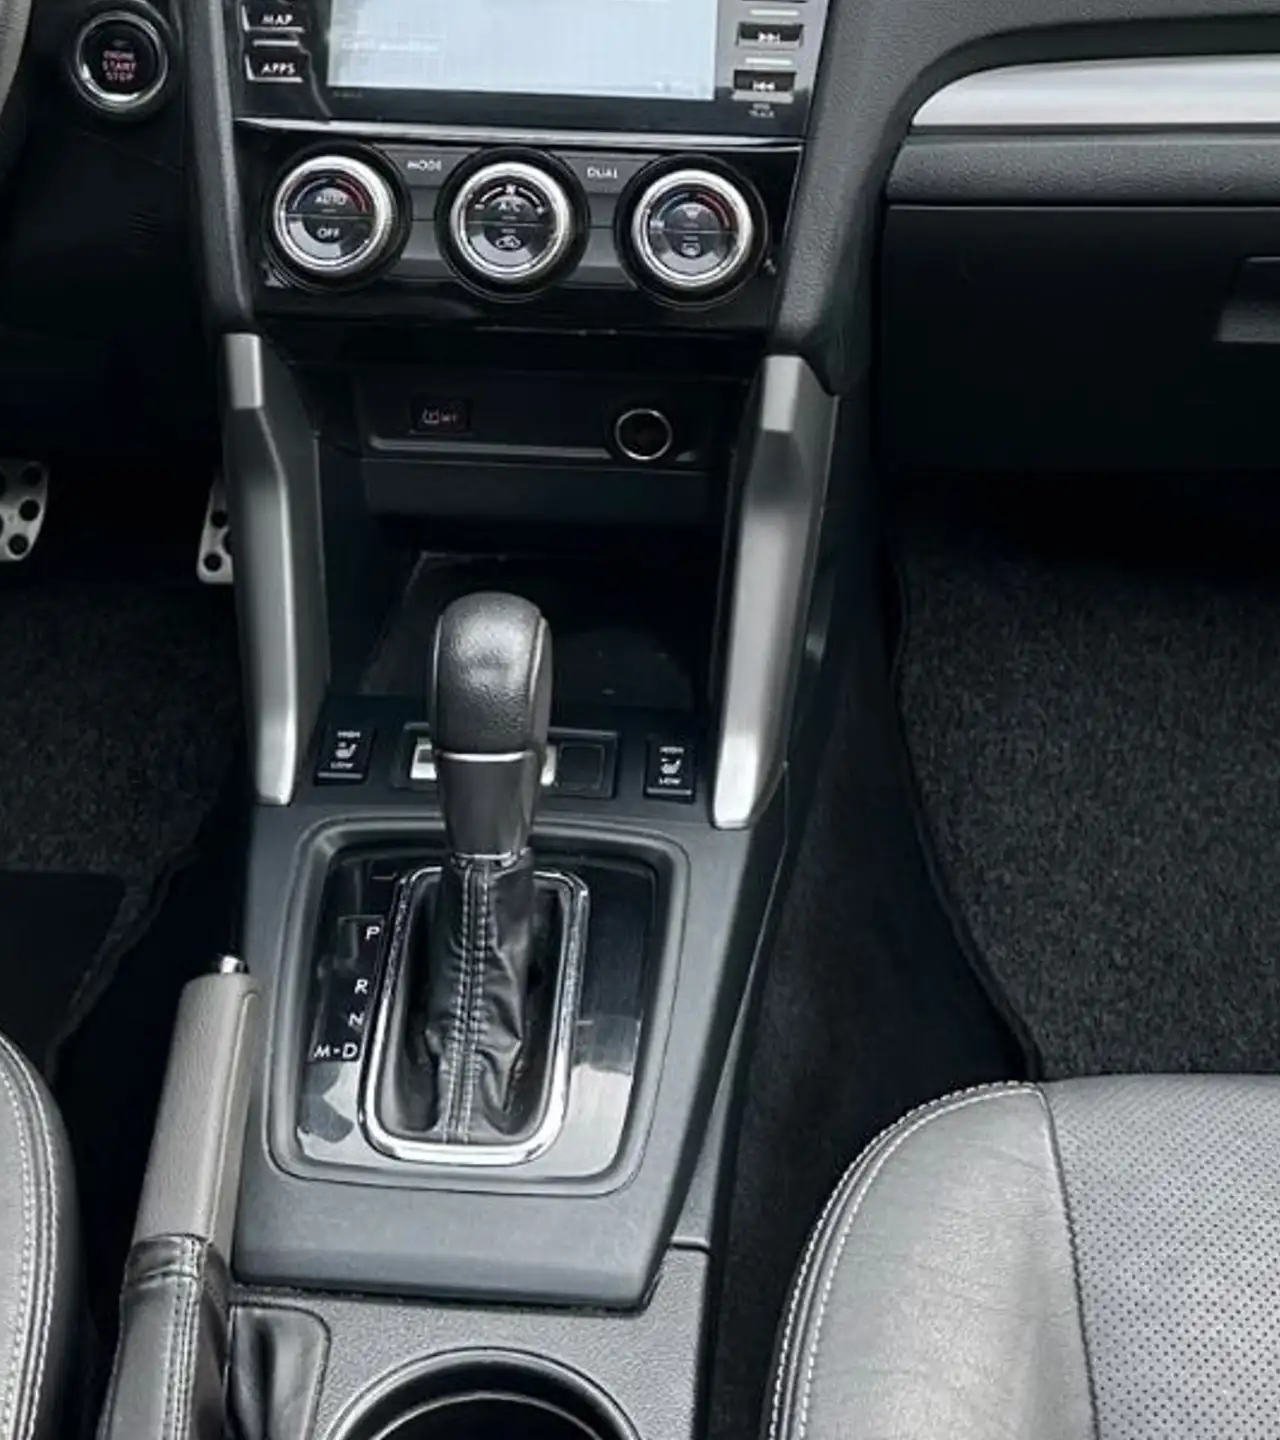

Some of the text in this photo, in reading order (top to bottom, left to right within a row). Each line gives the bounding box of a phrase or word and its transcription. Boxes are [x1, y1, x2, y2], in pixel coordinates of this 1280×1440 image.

[261, 14, 293, 26] MAP
[261, 62, 296, 75] APPS
[406, 159, 442, 172] MODE
[586, 166, 618, 179] DUAL
[315, 191, 348, 206] AUTO
[316, 227, 341, 240] OFF
[365, 925, 381, 941] P
[354, 978, 369, 995] R
[347, 1011, 366, 1028] N
